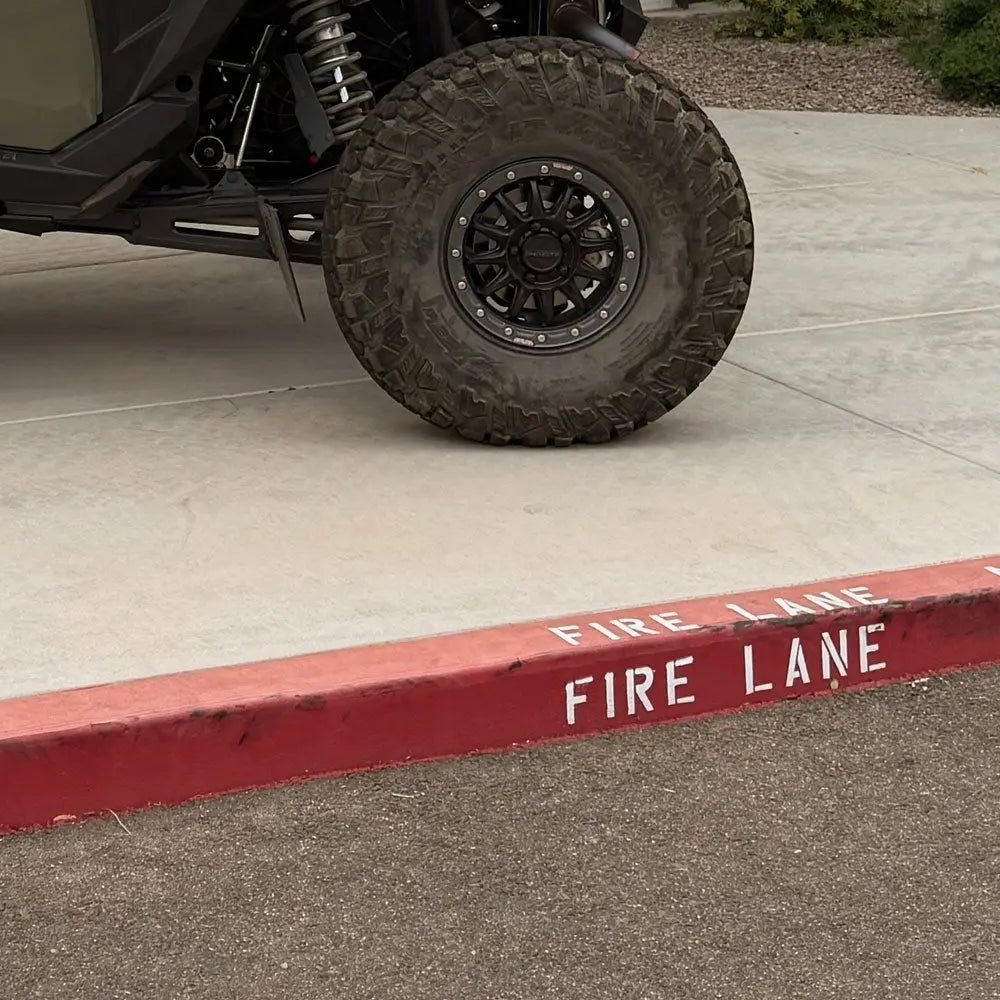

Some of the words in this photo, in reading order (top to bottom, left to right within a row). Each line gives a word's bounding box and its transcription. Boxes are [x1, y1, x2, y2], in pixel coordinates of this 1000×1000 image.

[548, 611, 701, 646] FIRE
[726, 586, 890, 622] LANE
[565, 655, 695, 725] FIRE
[744, 622, 887, 695] LANE
